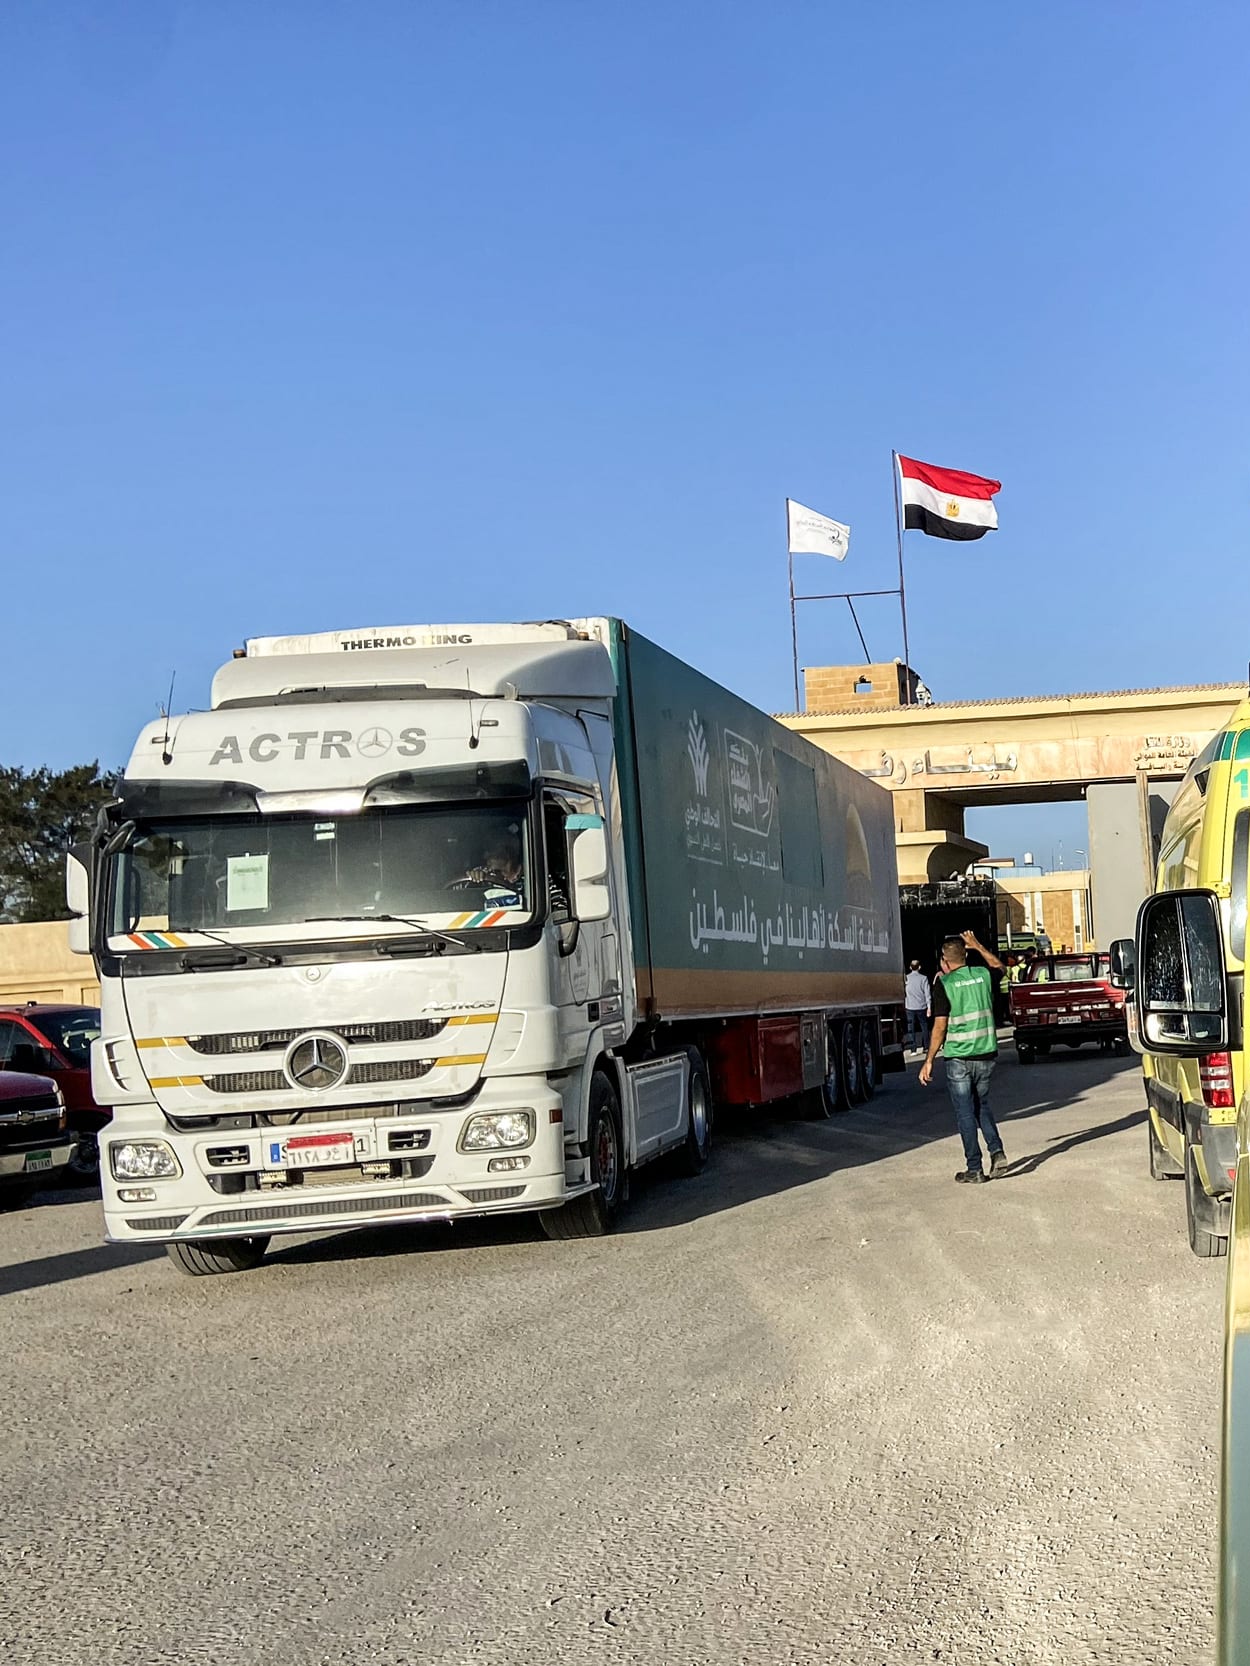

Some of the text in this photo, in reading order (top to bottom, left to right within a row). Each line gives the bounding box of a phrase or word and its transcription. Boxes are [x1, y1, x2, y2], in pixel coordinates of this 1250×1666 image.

[340, 636, 416, 651] THERMO
[861, 746, 1018, 785] ميناء رف
[689, 887, 889, 966] مسافة السكة لأهالينا في فلسطين
